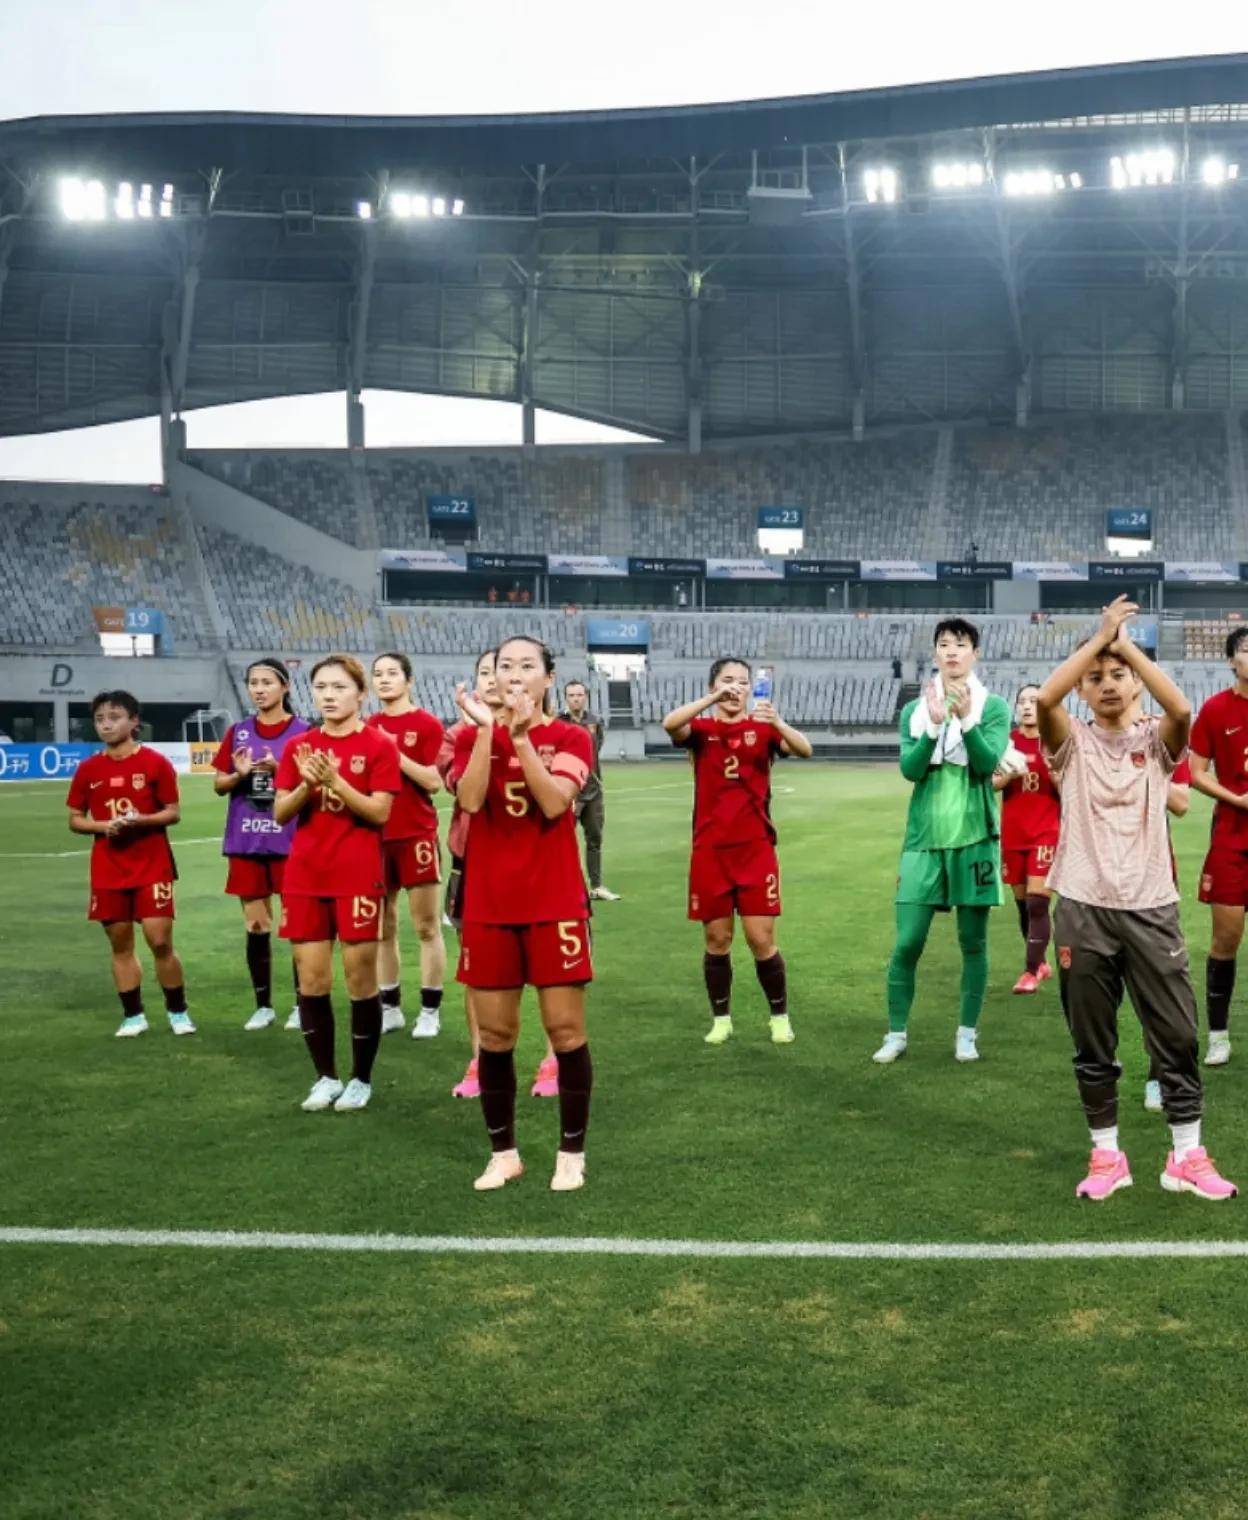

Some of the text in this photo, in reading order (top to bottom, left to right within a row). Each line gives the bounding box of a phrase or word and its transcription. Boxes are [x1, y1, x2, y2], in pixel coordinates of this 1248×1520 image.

[451, 500, 469, 513] 22
[781, 510, 799, 522] 23
[1130, 512, 1147, 525] 24
[128, 612, 149, 627] 19
[618, 624, 638, 637] 20
[51, 664, 73, 687] D
[724, 756, 739, 779] 2
[1022, 771, 1040, 793] 18
[105, 798, 132, 818] 19
[504, 782, 528, 817] 5
[242, 818, 282, 833] 2025
[414, 842, 432, 865] 6
[1037, 845, 1054, 863] 18
[970, 862, 994, 887] 12
[153, 883, 173, 900] 19
[766, 874, 778, 899] 2
[353, 896, 376, 918] 15
[558, 921, 581, 956] 5
